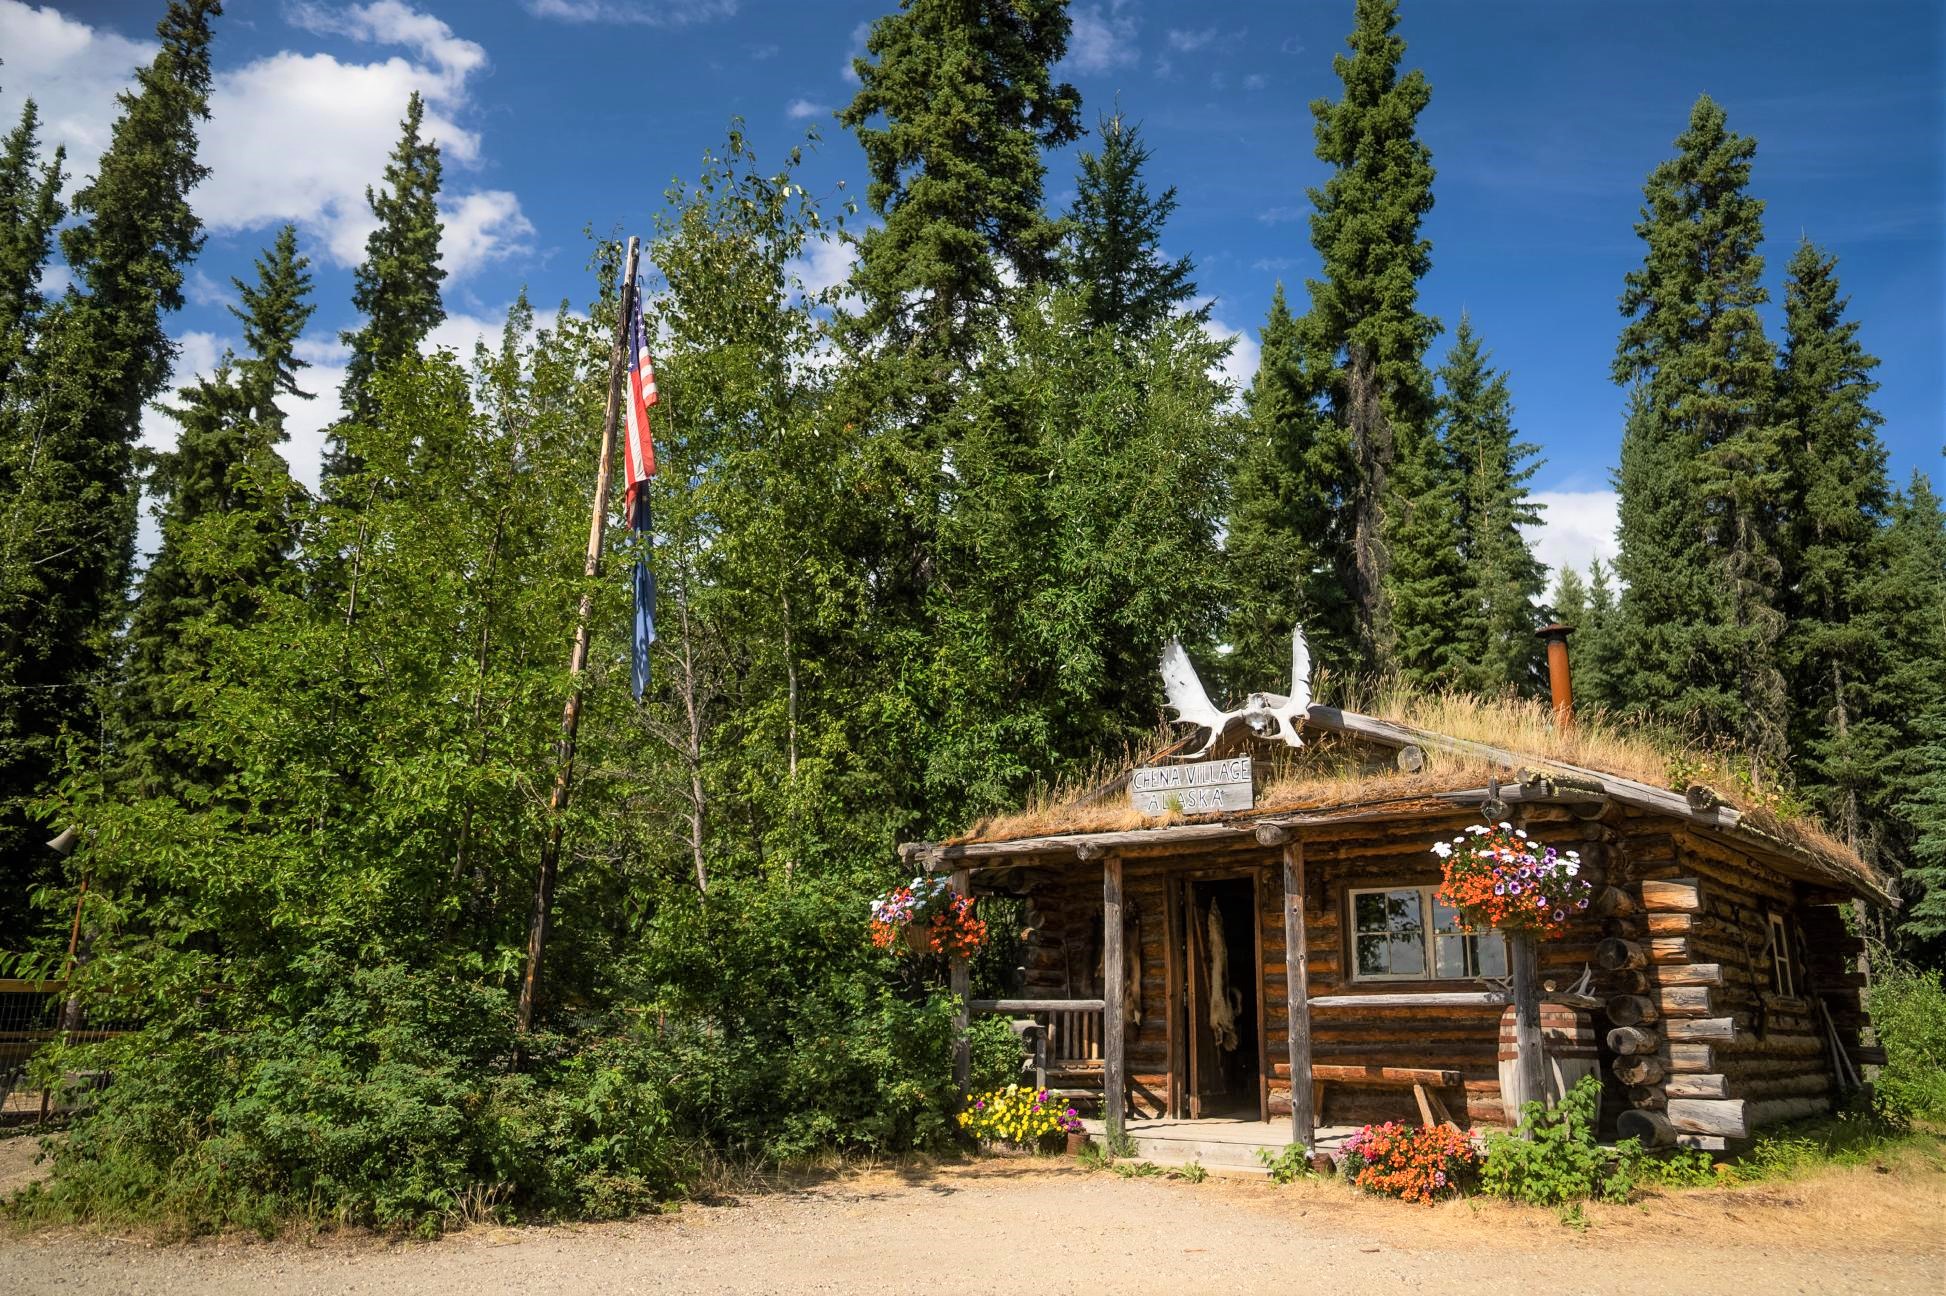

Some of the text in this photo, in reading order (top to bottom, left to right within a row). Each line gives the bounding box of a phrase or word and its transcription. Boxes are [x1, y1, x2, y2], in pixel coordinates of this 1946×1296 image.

[1133, 760, 1251, 789] CHENA VILLAGE
[1148, 789, 1223, 810] ALASKA
